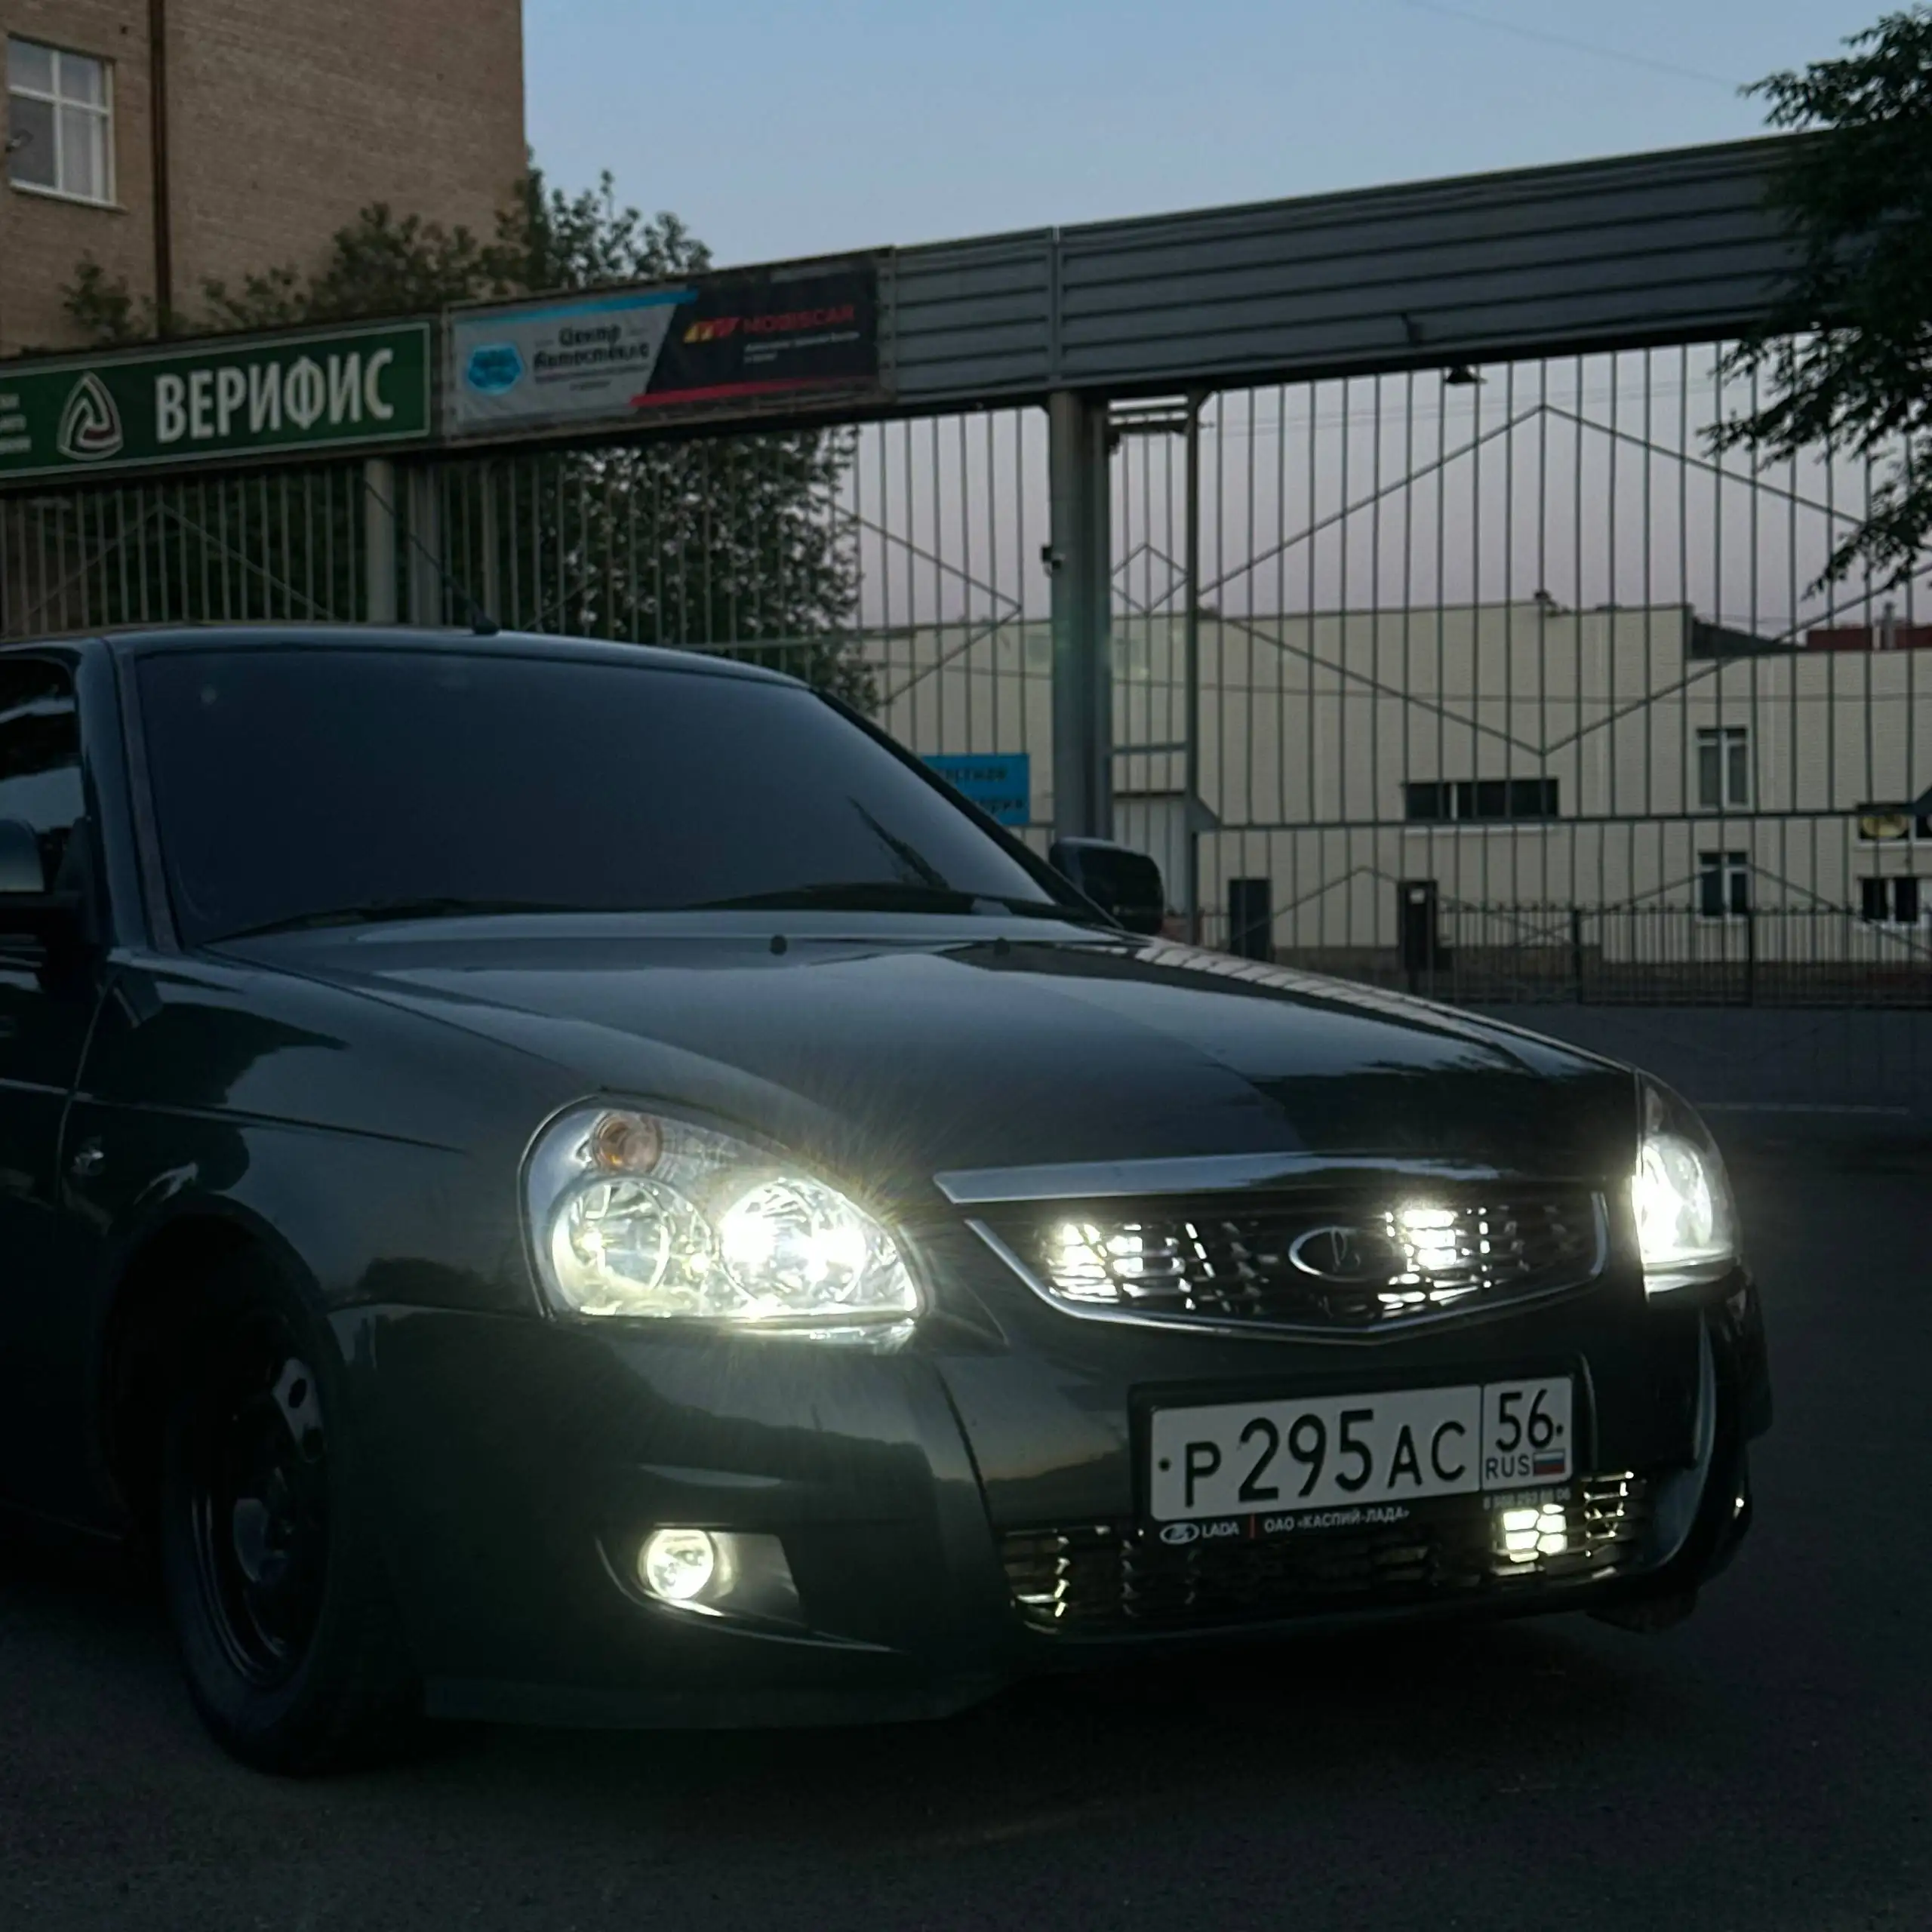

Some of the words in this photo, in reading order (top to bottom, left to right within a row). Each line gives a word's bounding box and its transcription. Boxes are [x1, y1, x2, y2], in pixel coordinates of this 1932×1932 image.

[155, 348, 394, 443] ВЕРИФИС
[1495, 1388, 1553, 1451] 56
[1485, 1453, 1531, 1480] RUS
[1202, 1521, 1239, 1538] LADA
[1264, 1516, 1294, 1533] ОАО
